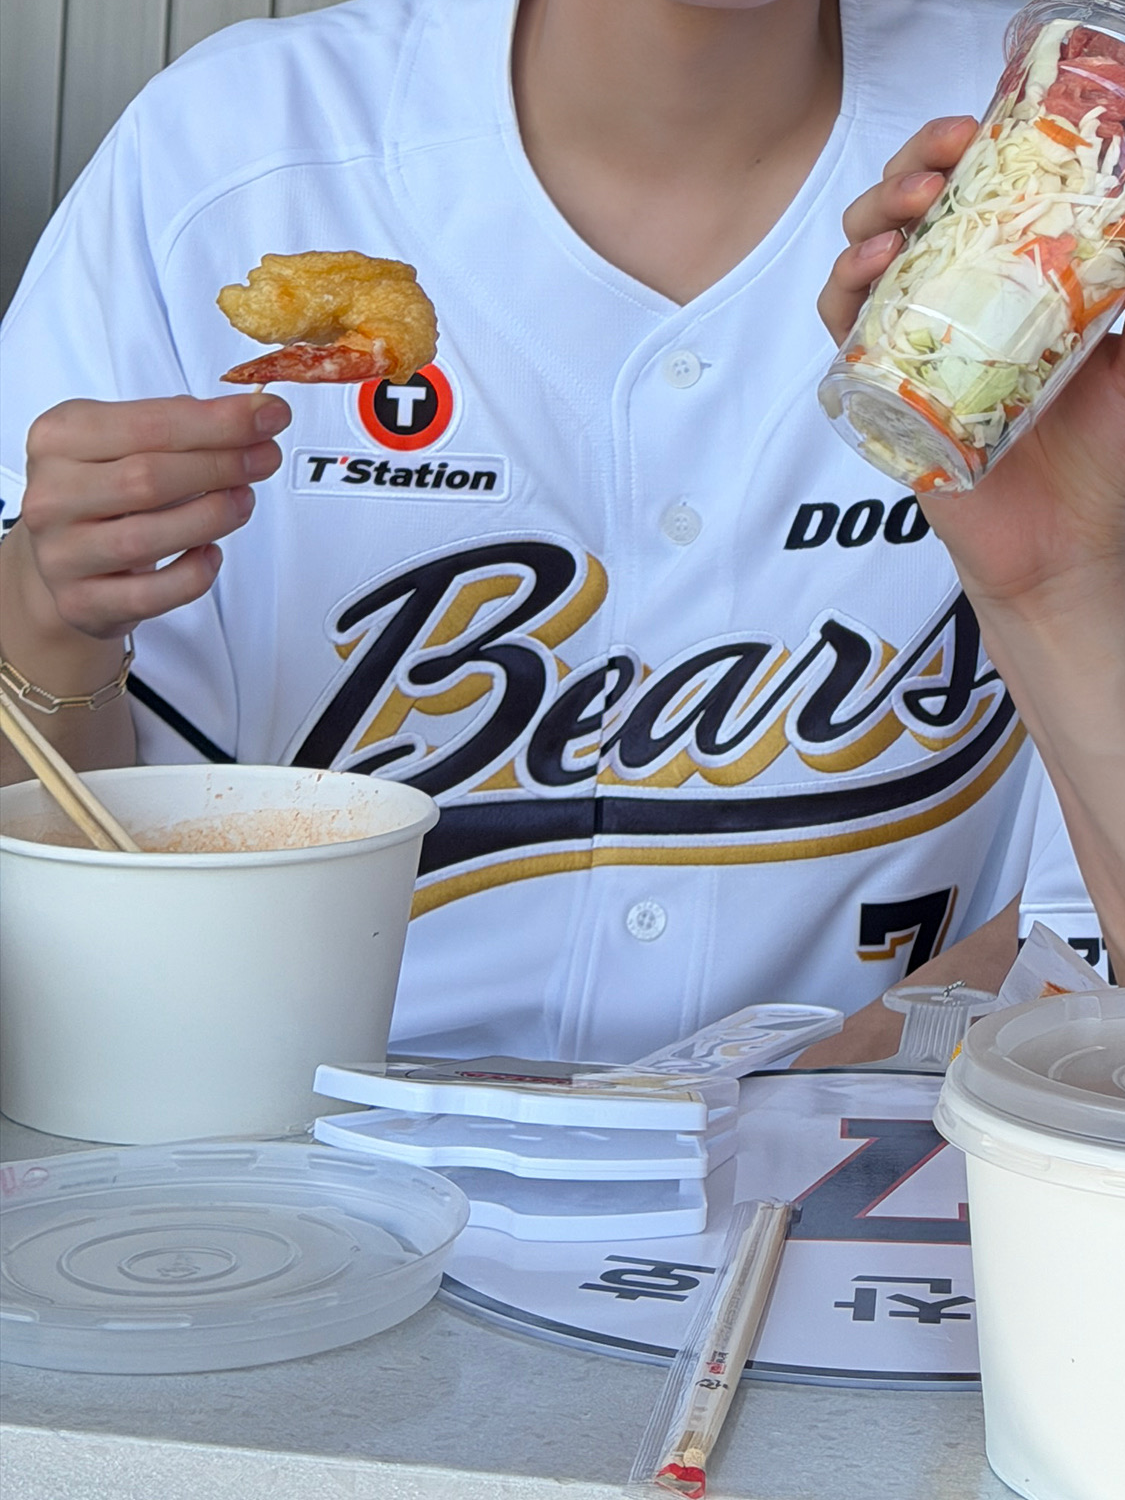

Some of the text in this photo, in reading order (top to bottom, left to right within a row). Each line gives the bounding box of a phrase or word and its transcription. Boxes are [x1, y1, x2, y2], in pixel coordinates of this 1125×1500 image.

[386, 385, 427, 428] T
[307, 456, 497, 490] T'Station
[290, 533, 1006, 798] Bears
[857, 885, 958, 980] 7
